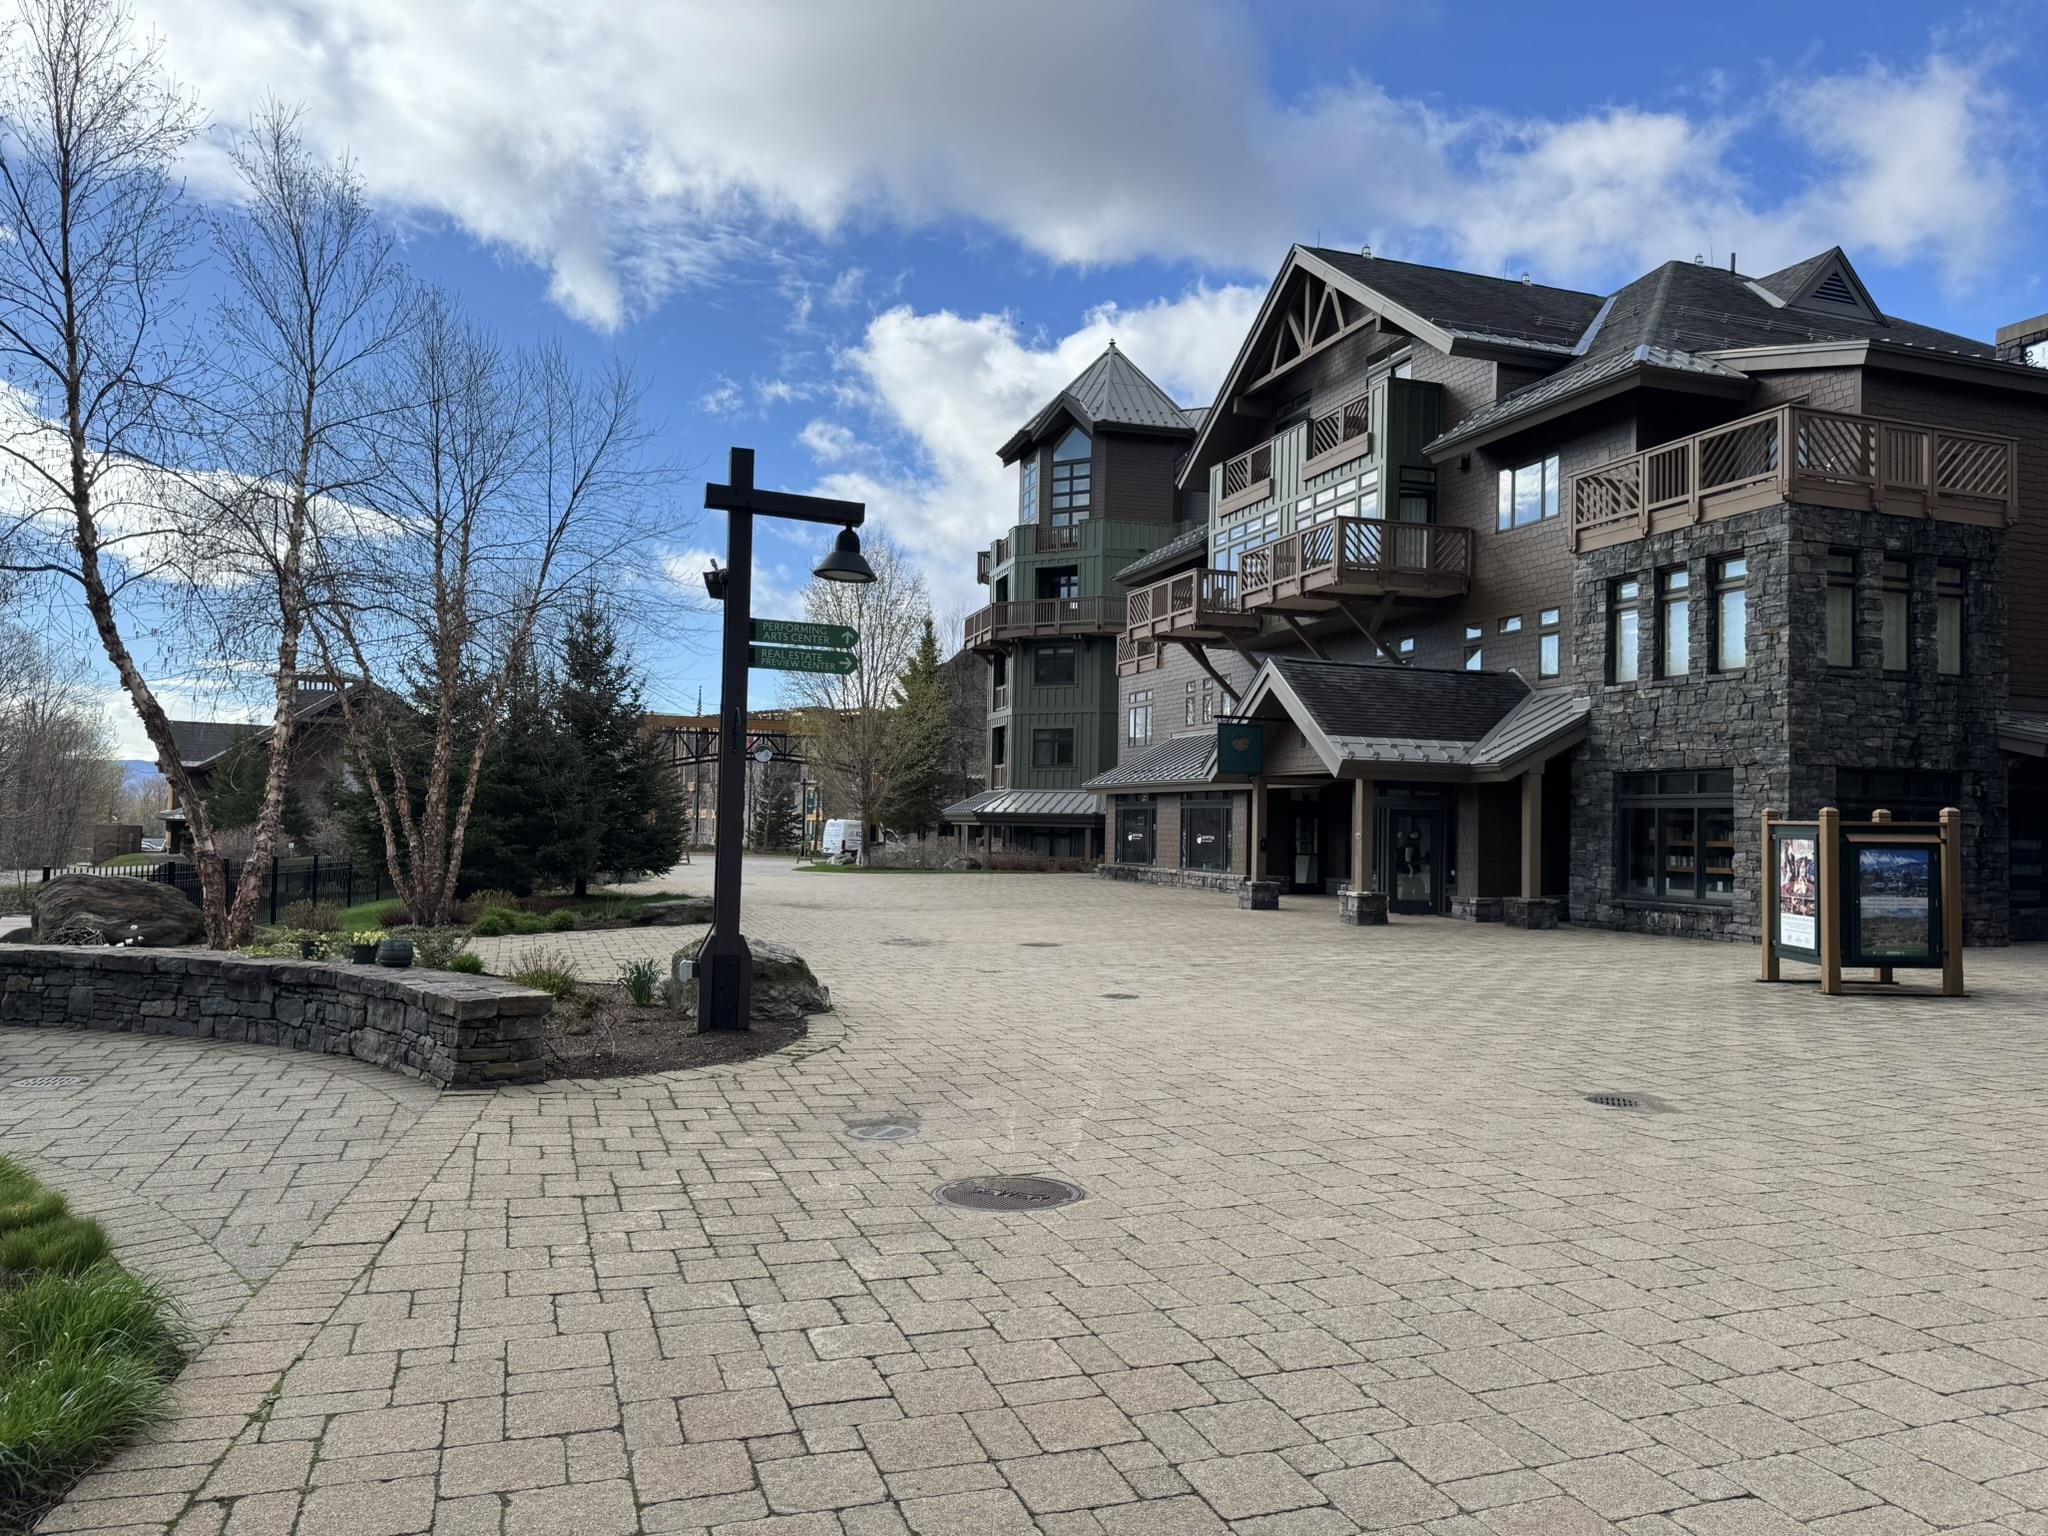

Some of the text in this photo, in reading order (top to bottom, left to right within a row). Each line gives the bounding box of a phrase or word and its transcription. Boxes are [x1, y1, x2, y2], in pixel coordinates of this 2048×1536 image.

[762, 623, 827, 634] PERFORMING
[763, 631, 829, 644] ARTS CENTER
[761, 649, 823, 661] REAL ESTATE
[761, 657, 835, 670] PREVIEW CENTER
